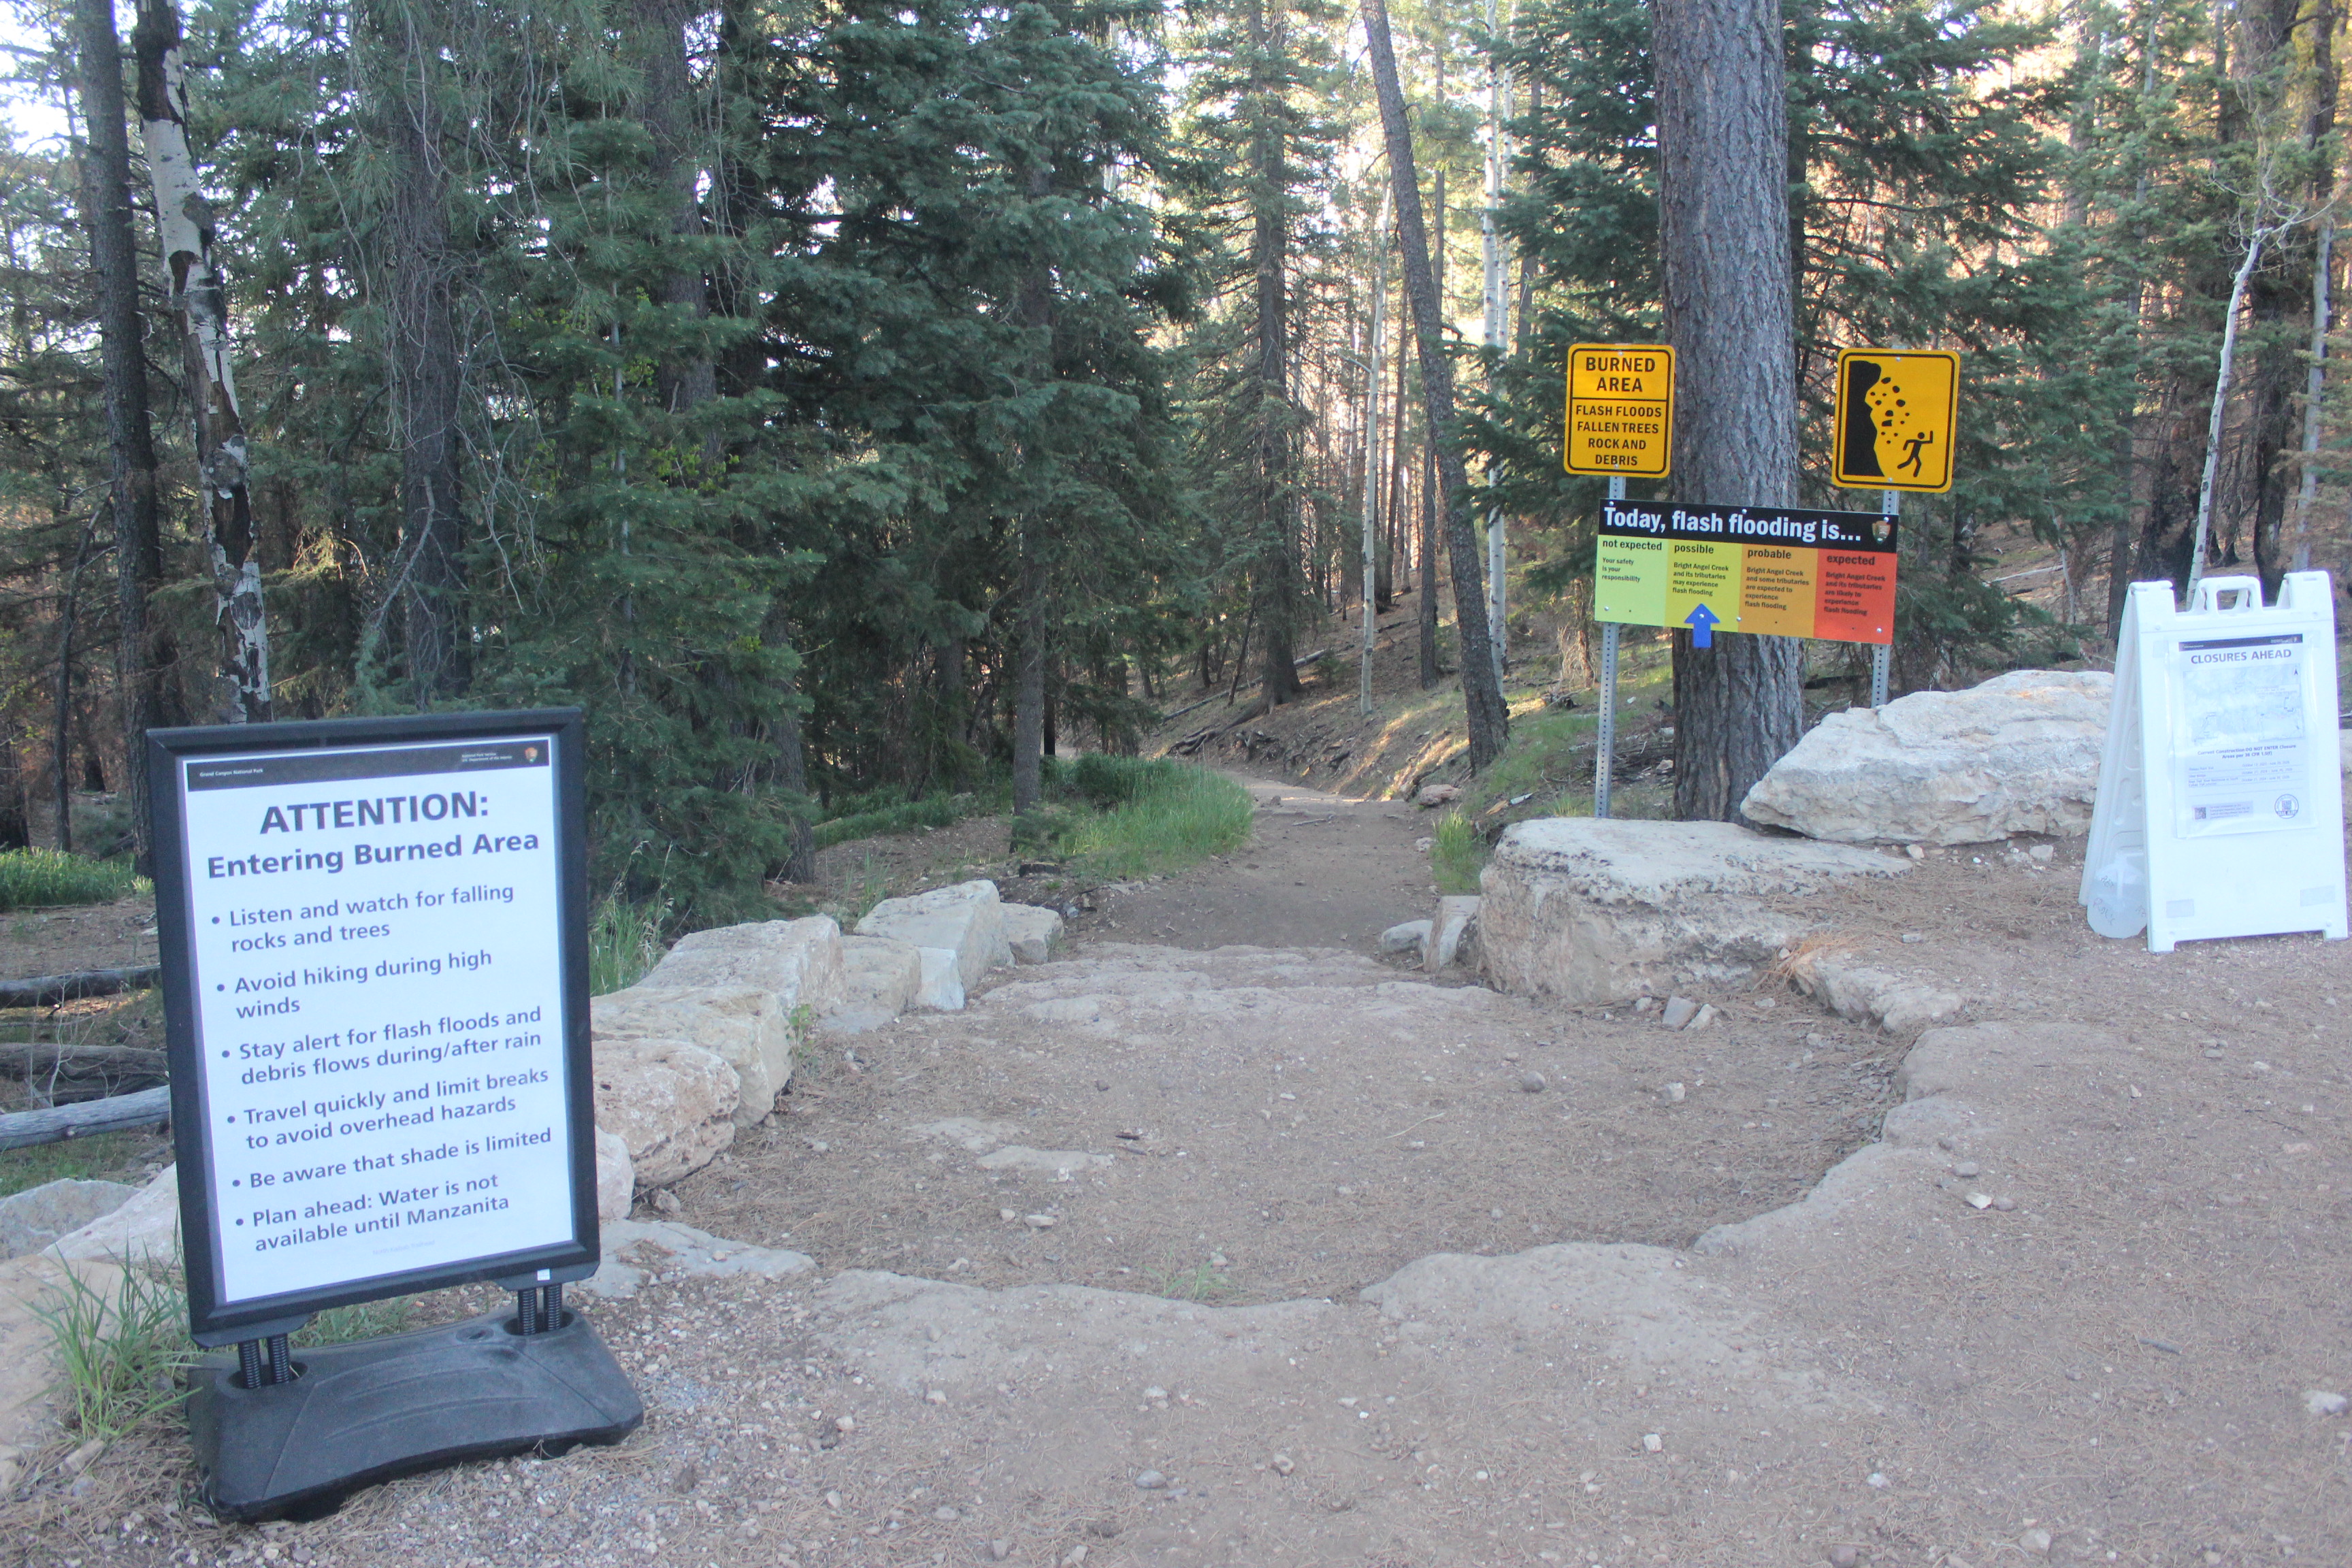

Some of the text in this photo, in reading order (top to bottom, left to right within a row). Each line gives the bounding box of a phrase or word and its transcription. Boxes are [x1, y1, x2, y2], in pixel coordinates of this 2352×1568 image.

[1586, 357, 1655, 372] BURNED
[1596, 377, 1642, 392] AREA
[1575, 405, 1661, 417] FLASH FLOODS
[1577, 421, 1659, 434] FALLEN TREES
[1588, 438, 1646, 449] ROCK AND
[1595, 454, 1637, 466] DEBRIS
[1604, 506, 1861, 542] Today, flash flooding is...
[1603, 539, 1662, 550] not expected
[1674, 544, 1714, 553] possible
[1748, 549, 1791, 559] probable
[1827, 555, 1875, 566] expected
[1616, 558, 1635, 566] safety
[1673, 561, 1693, 570] Bright
[1695, 572, 1726, 580] tributaries
[1746, 566, 1765, 575] Bright
[1766, 568, 1784, 576] Angel
[1601, 575, 1641, 583] responsibility
[1776, 577, 1810, 586] tributaries
[1688, 588, 1713, 597] flooding
[1761, 602, 1786, 611] flooding
[2191, 649, 2291, 665] CLOSURES AHEAD
[259, 790, 489, 835] ATTENTION:
[207, 833, 539, 879] Entering Burned Area
[229, 884, 514, 927] Listen and watch for falling
[231, 924, 390, 953] rocks and trees
[234, 949, 492, 994] Avoid hiking during high
[235, 996, 300, 1019] winds
[239, 1005, 541, 1060] Stay alert for flash floods and
[241, 1031, 541, 1085] debris flows during/after rain
[243, 1068, 549, 1124] Travel quickly and limit breaks
[245, 1095, 516, 1149] to avoid overhead hazards
[250, 1126, 551, 1188] Be aware that shade is limited
[252, 1174, 499, 1227] Plan ahead: Water is not
[255, 1196, 509, 1252] available until Manzanita
